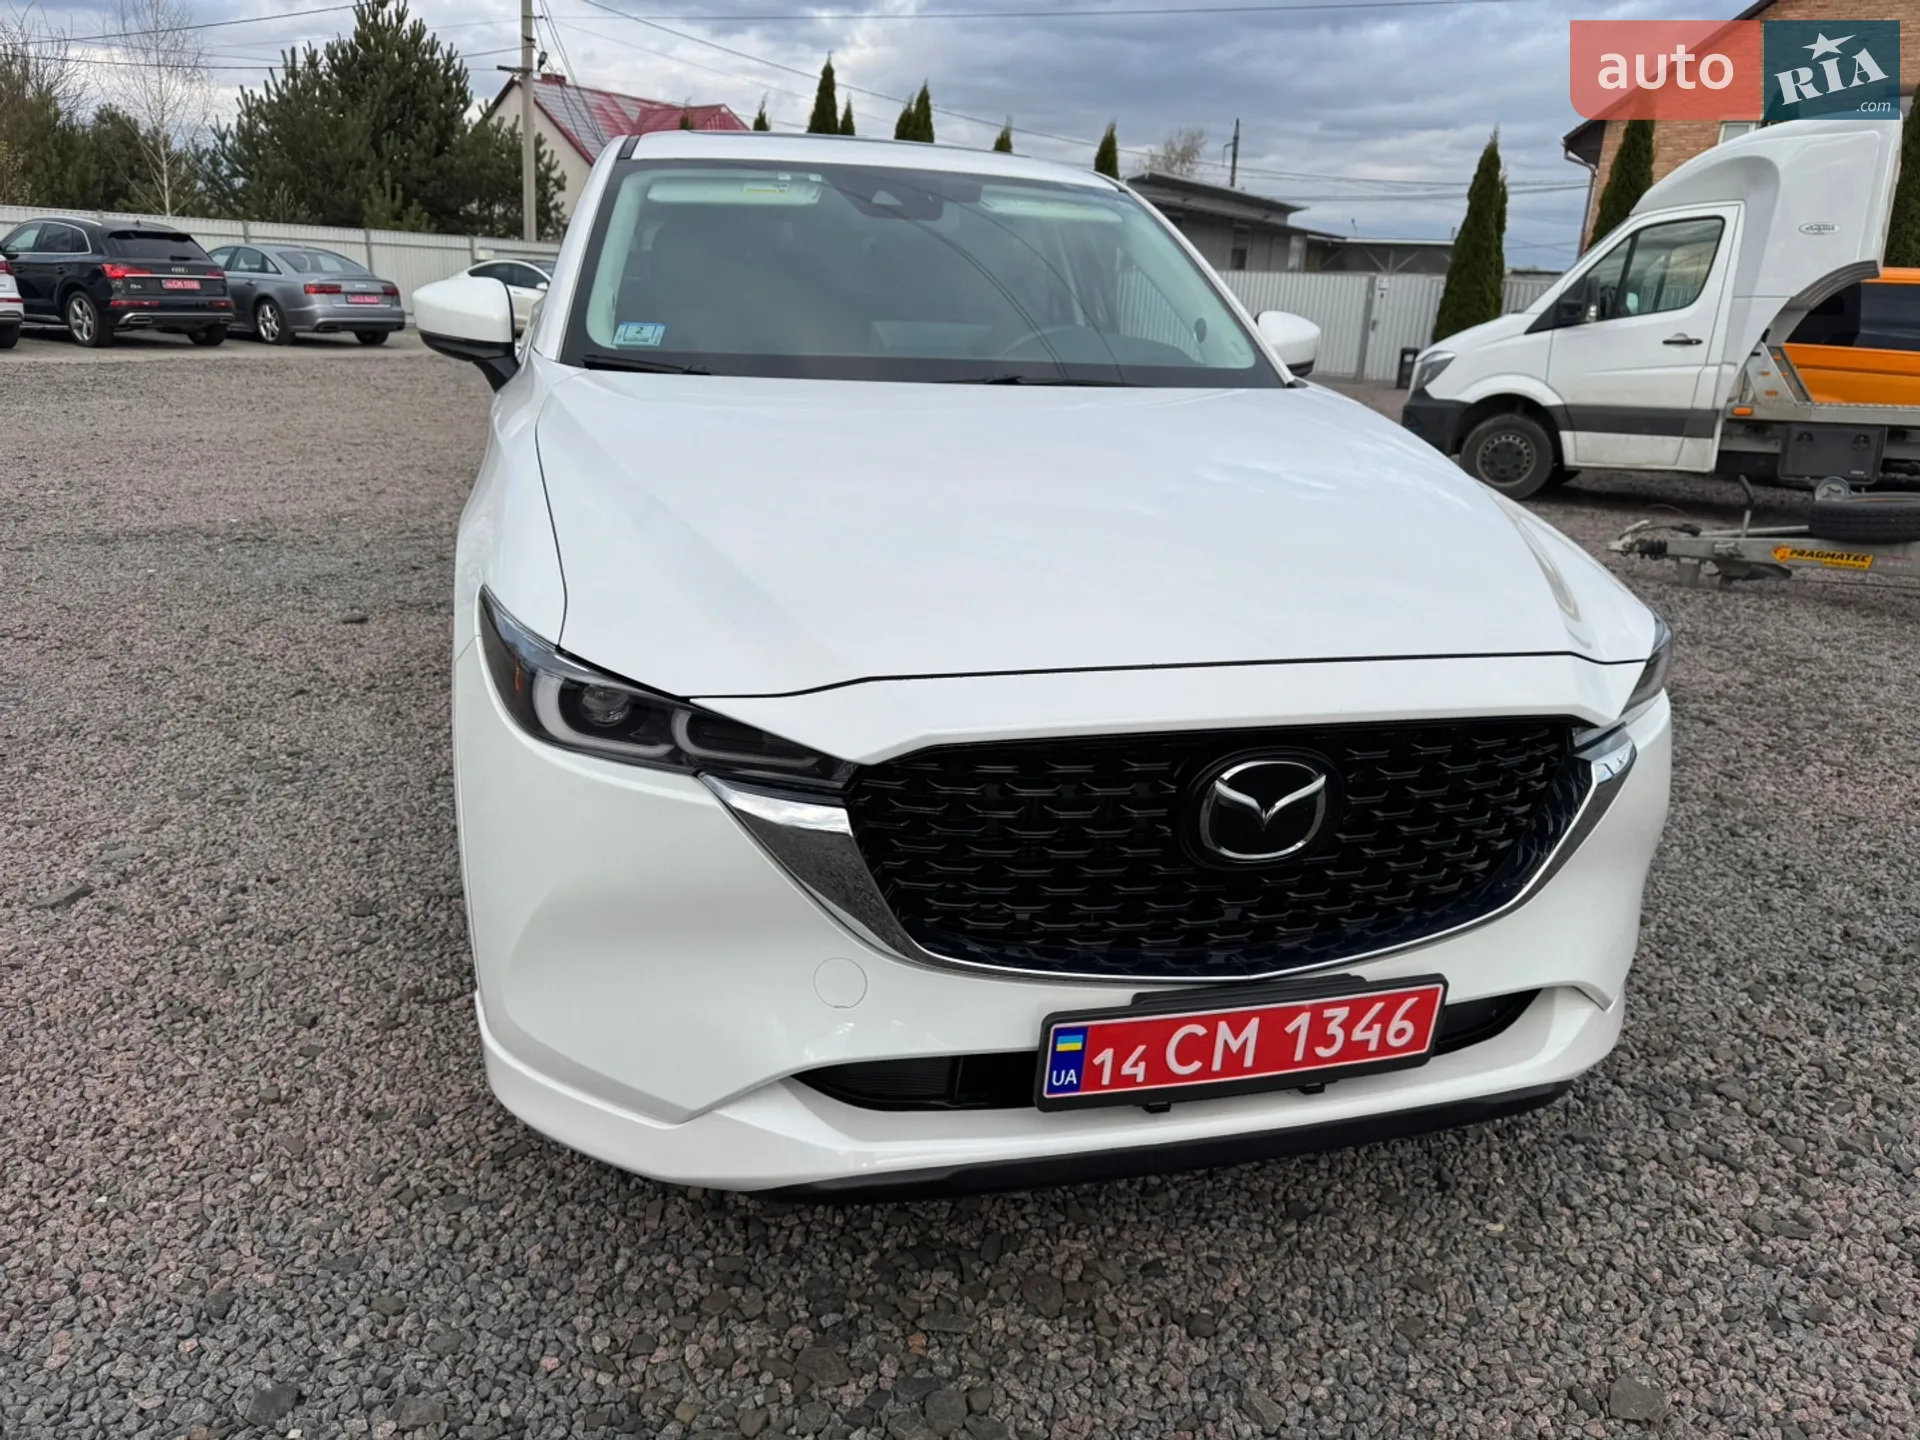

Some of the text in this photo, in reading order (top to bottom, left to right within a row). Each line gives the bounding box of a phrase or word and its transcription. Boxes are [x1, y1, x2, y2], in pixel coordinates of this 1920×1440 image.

[1789, 548, 1871, 563] PRAGMATEC
[1092, 997, 1420, 1086] 14 CM 1346
[1051, 1068, 1078, 1086] UA
